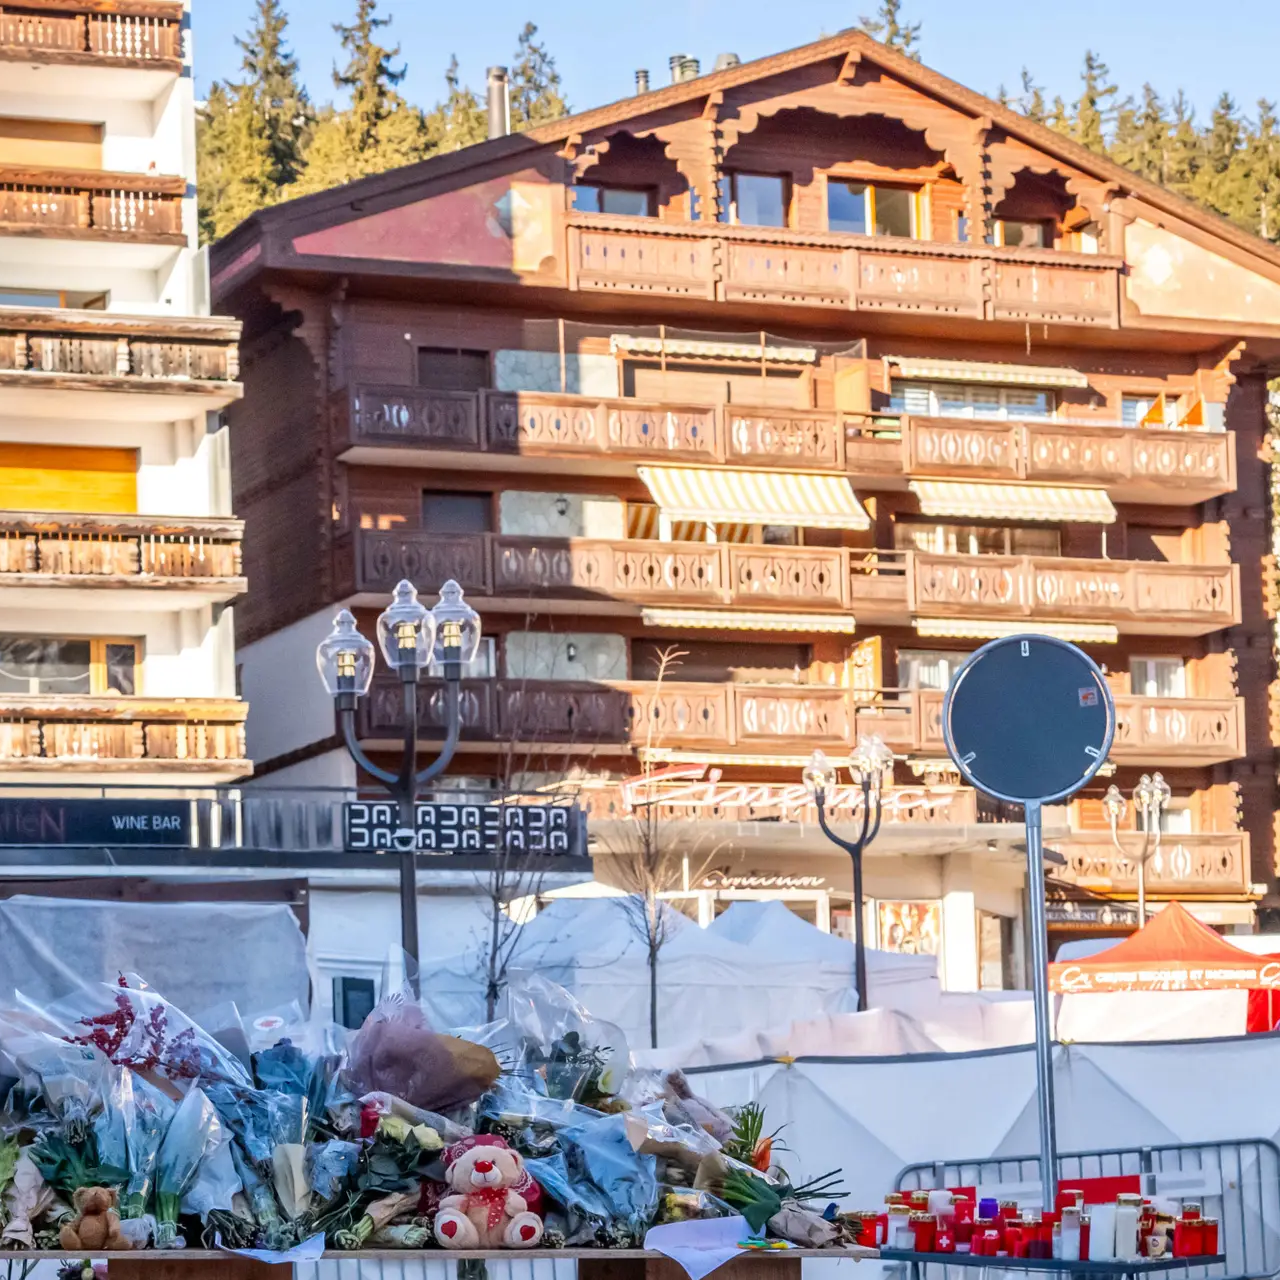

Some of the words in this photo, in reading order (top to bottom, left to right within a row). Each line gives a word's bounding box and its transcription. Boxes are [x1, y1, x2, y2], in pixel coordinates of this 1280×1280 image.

[622, 763, 952, 810] Cinema
[112, 815, 149, 830] WINE
[152, 815, 181, 830] BAR
